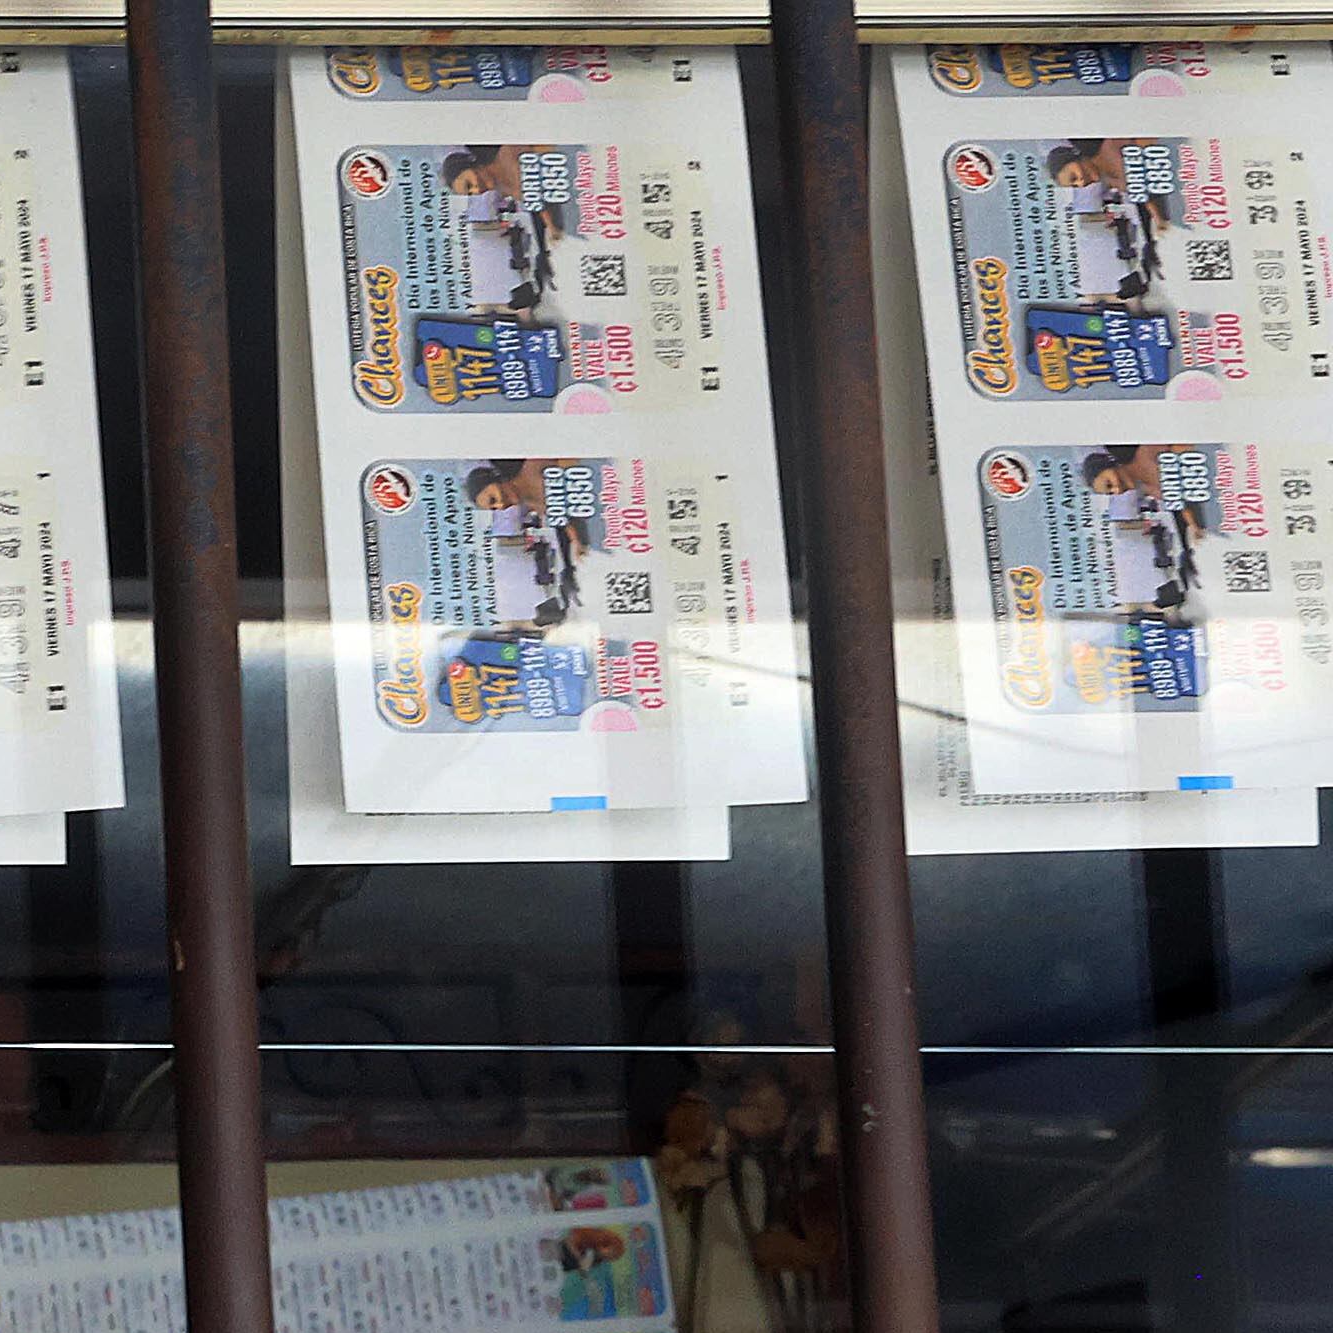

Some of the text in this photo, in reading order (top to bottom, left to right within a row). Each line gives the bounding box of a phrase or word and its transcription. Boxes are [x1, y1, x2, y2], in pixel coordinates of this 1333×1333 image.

[518, 152, 544, 211] SORTEO
[540, 152, 571, 203] 6850
[1121, 145, 1149, 202] SORTEO
[1143, 145, 1176, 194] 6850
[356, 266, 400, 402] Chances
[968, 257, 1014, 391] Chances
[1103, 309, 1141, 385] 8989-1147
[455, 346, 501, 399] 1147
[493, 320, 529, 398] 8989-1147
[585, 339, 606, 378] VALE
[1065, 335, 1113, 387] 1147
[542, 466, 569, 526] SORTEO
[564, 466, 596, 517] 6850
[1157, 451, 1185, 509] SORTEO
[1178, 451, 1212, 501] 6850
[380, 582, 425, 721] Chances
[1004, 566, 1050, 703] Chances
[479, 664, 526, 717] 1147
